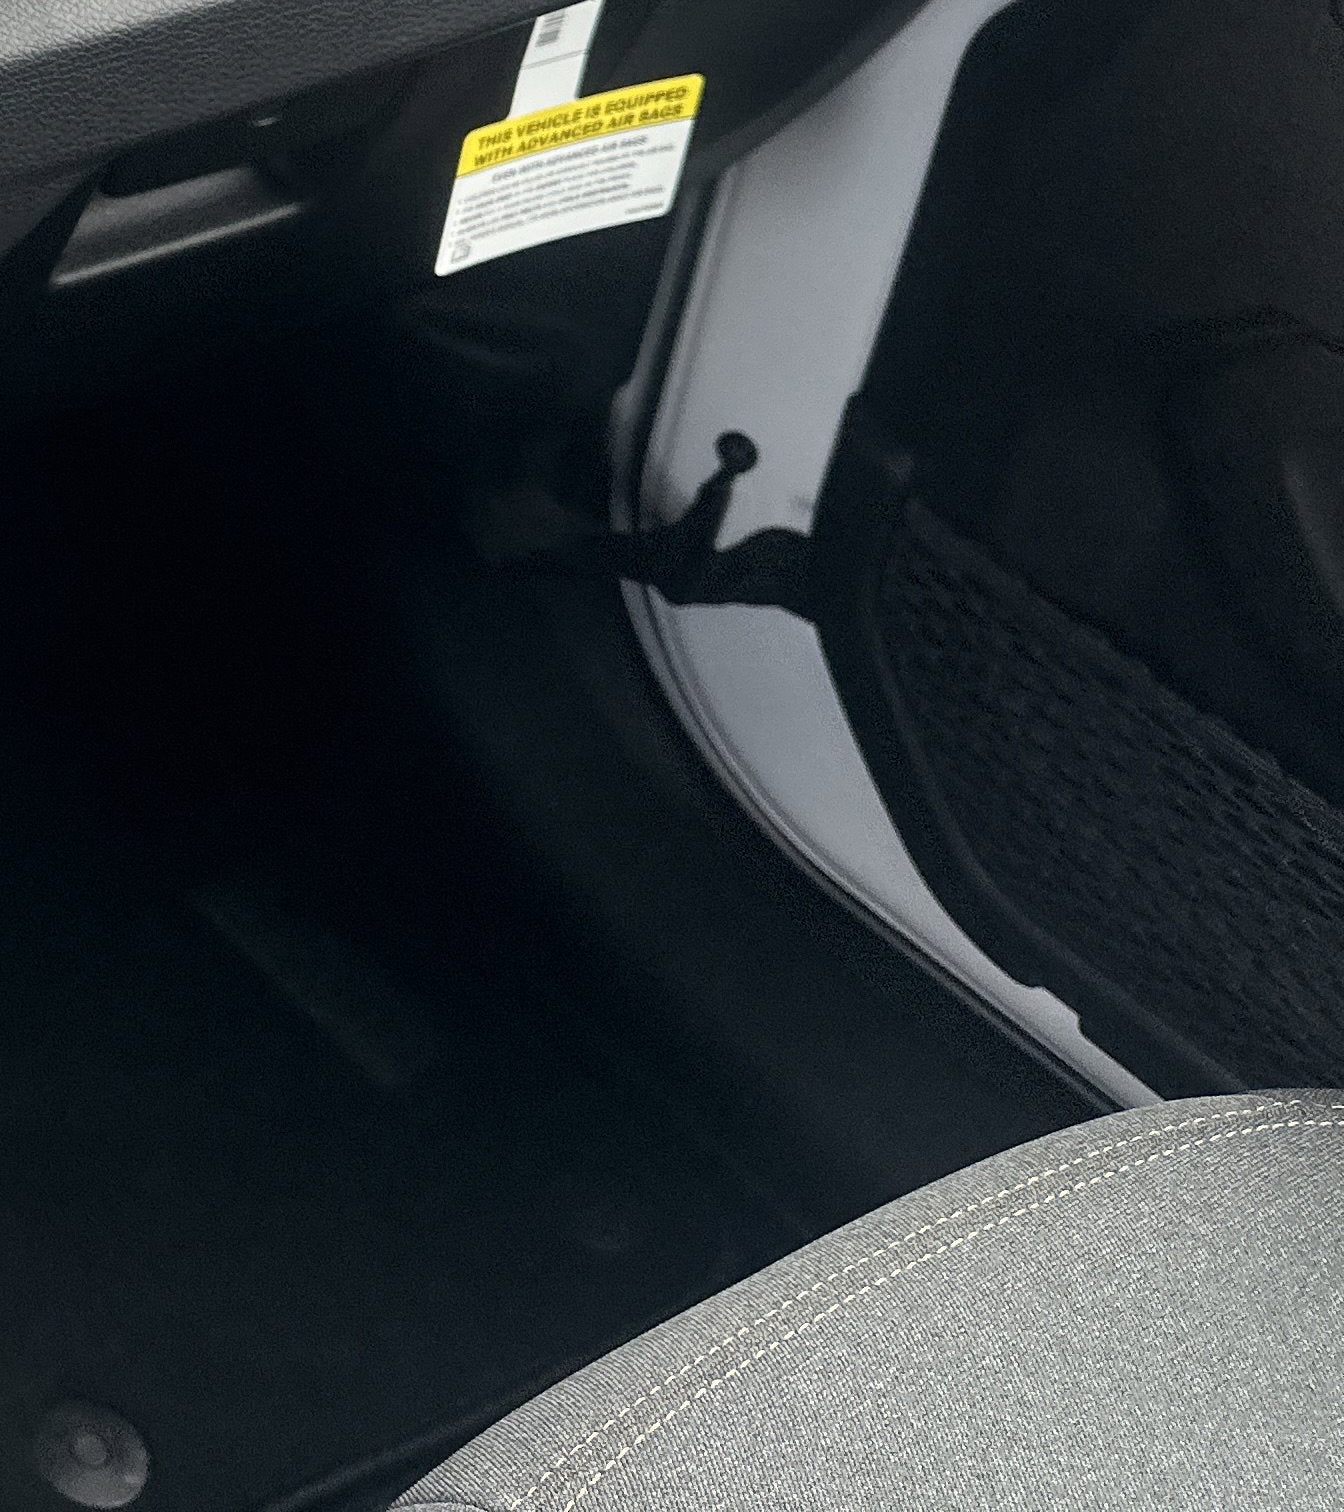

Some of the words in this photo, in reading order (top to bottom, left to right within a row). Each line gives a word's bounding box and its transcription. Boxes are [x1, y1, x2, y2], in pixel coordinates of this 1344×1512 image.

[474, 144, 513, 167] WITH
[518, 121, 603, 154] ADVANCED
[606, 111, 635, 128] AIR
[639, 103, 685, 124] BAGS
[478, 128, 512, 149] THIS
[517, 112, 583, 138] VEHICLE
[584, 103, 600, 118] IS
[604, 86, 690, 115] EQUIPPED
